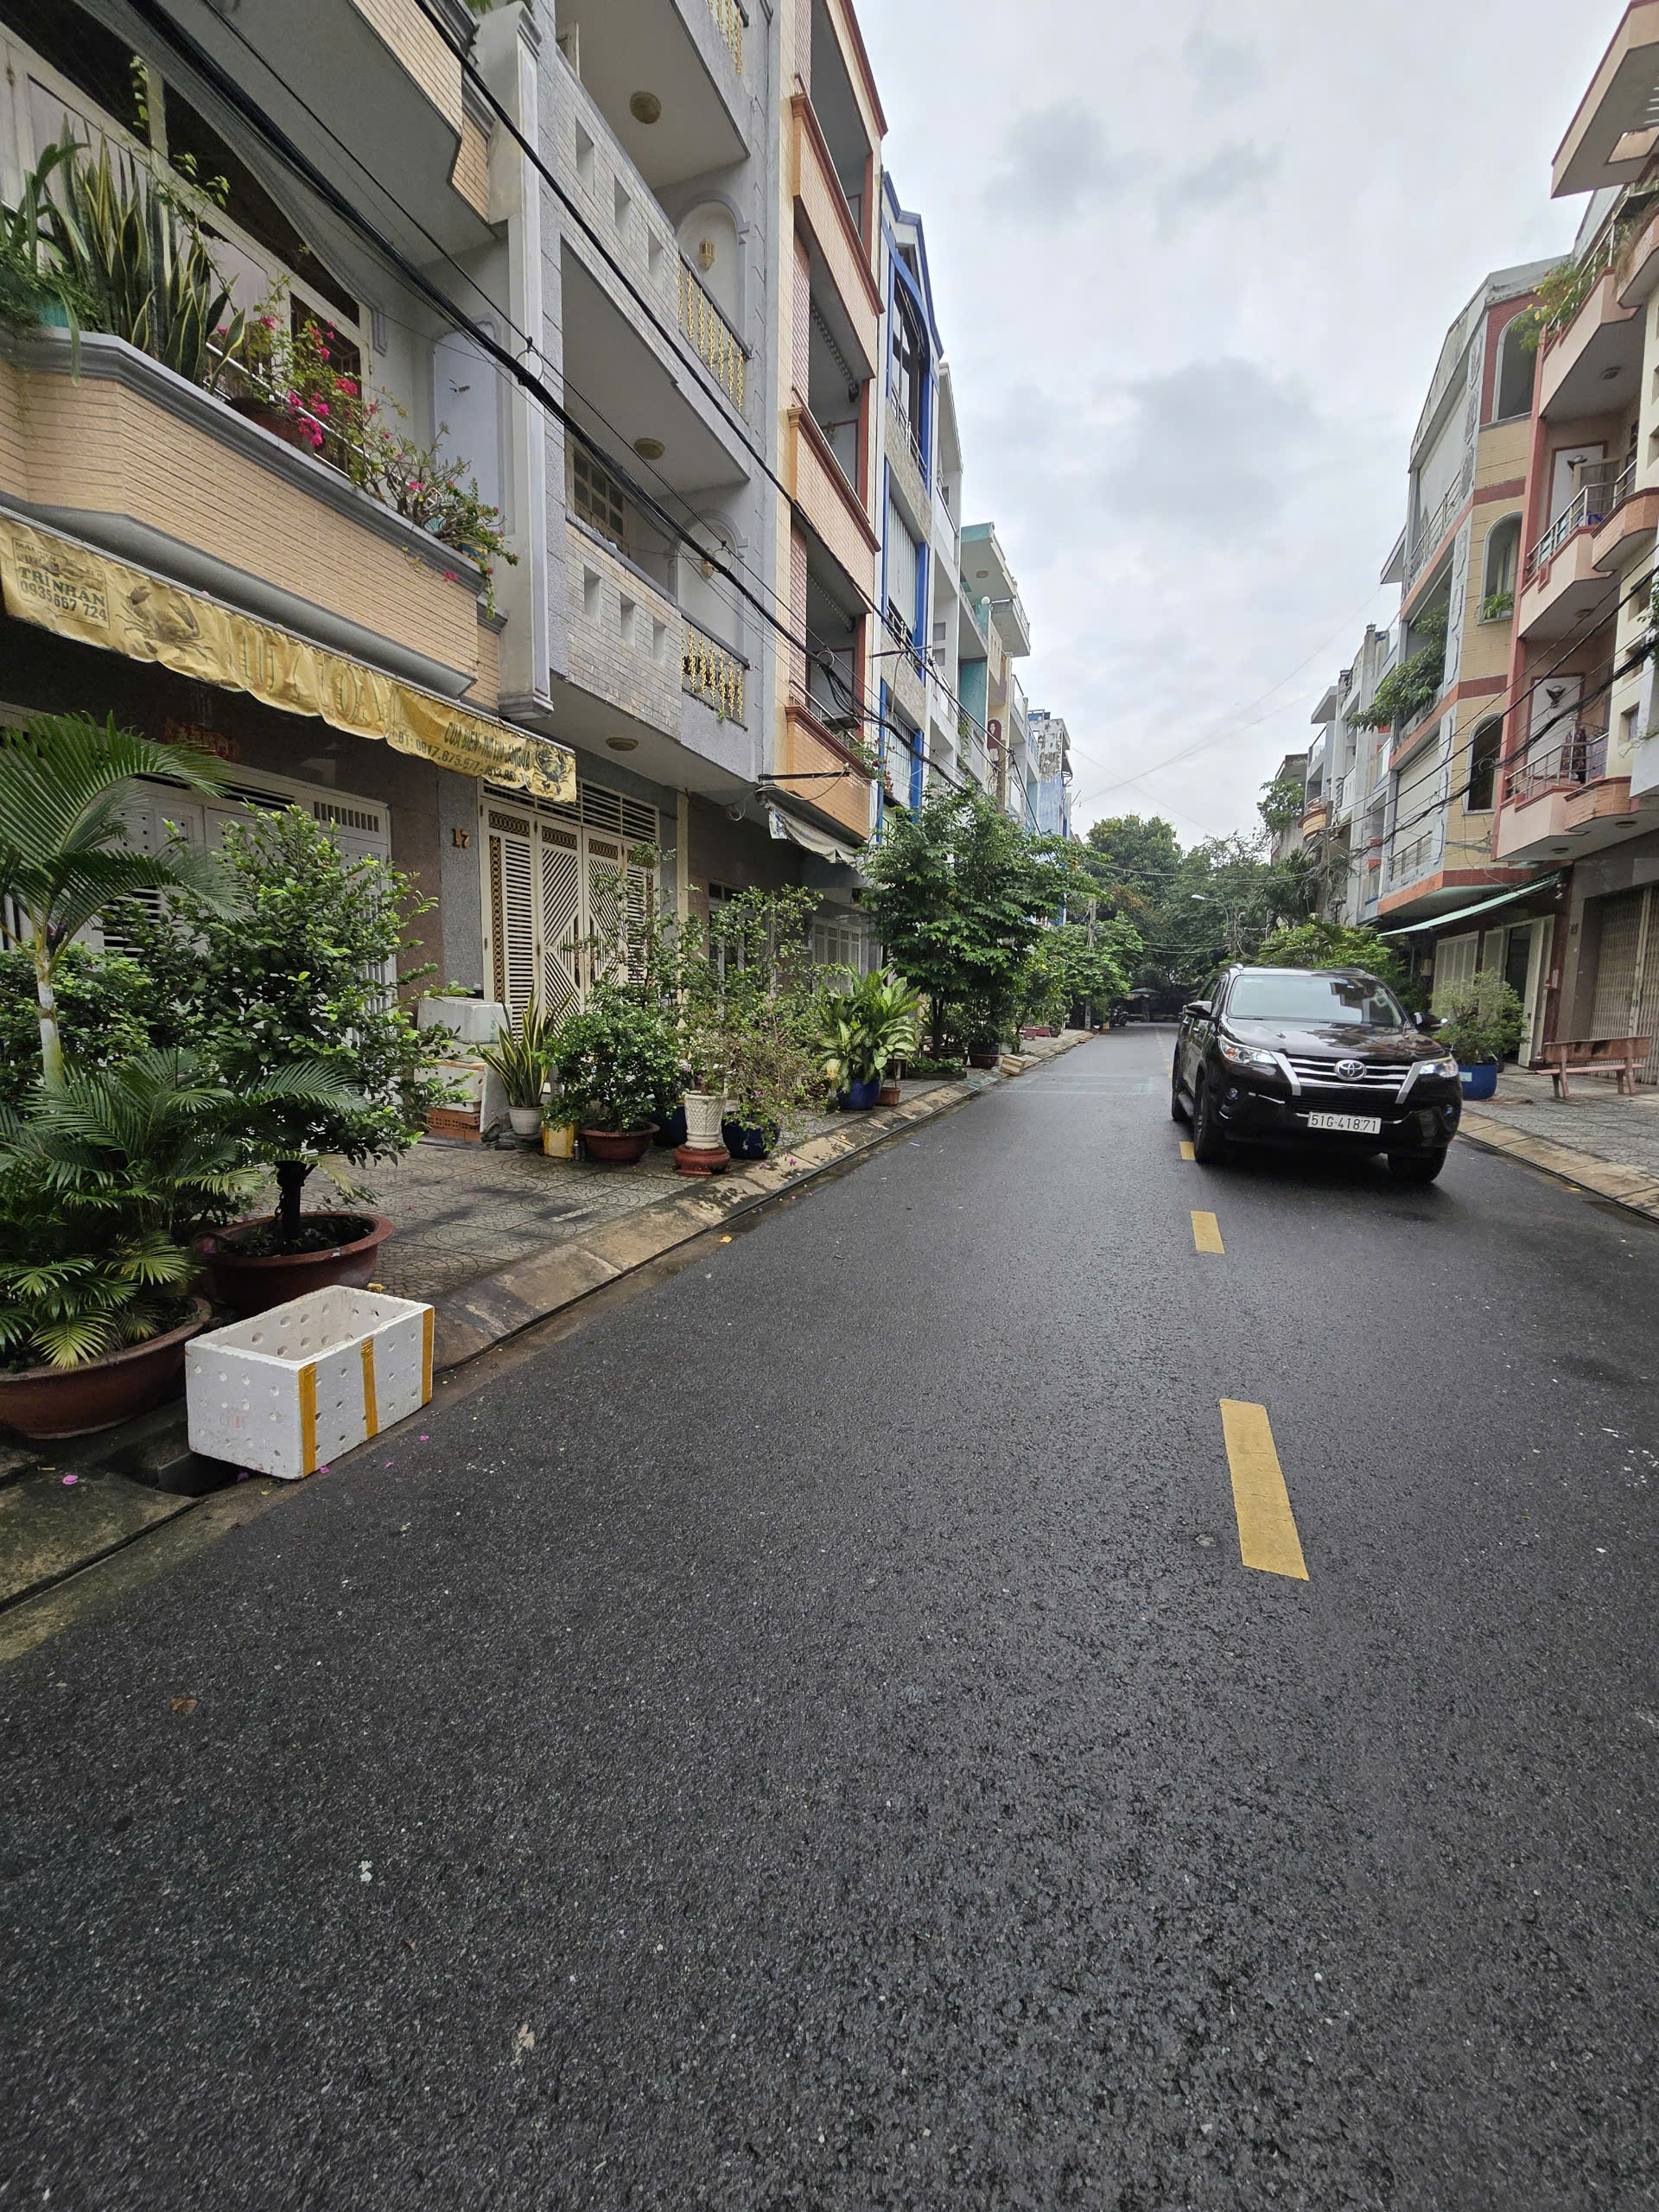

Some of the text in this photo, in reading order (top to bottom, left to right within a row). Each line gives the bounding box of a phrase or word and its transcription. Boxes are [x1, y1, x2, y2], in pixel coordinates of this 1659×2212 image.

[20, 580, 108, 622] 0935 667 724
[444, 721, 462, 748] CUA
[452, 829, 471, 850] 17
